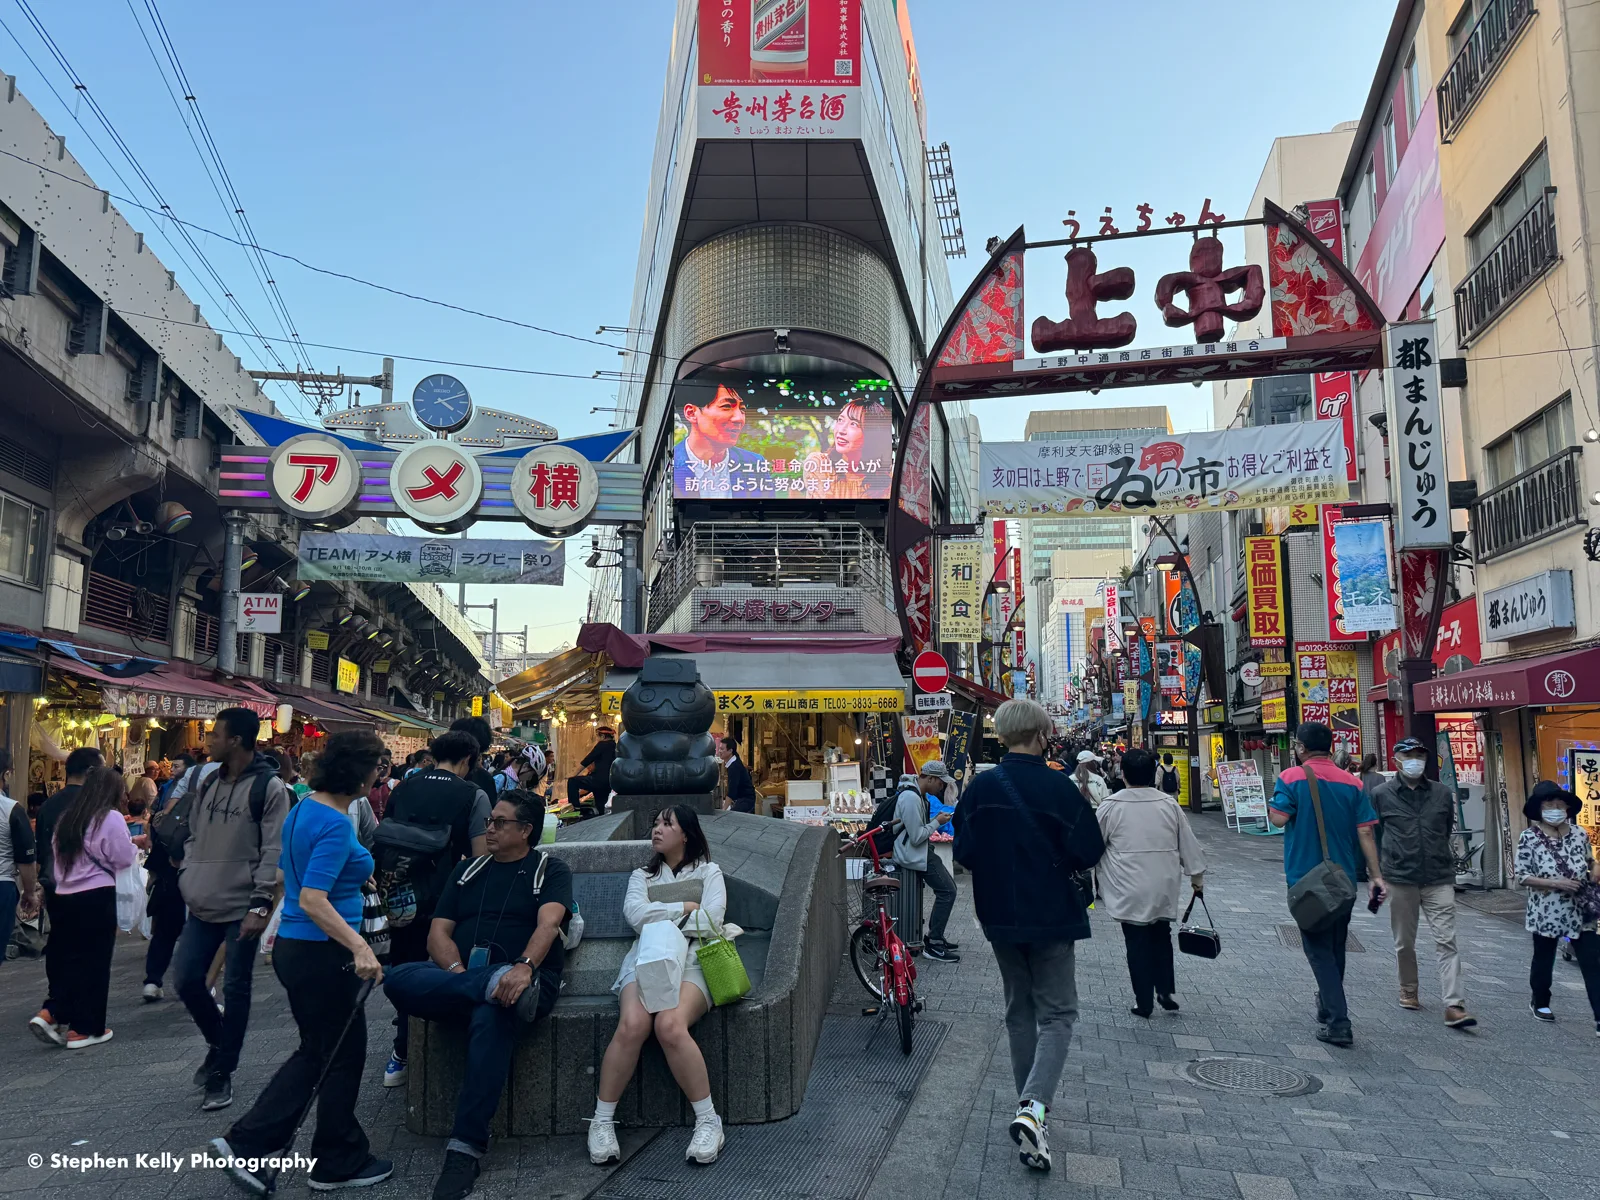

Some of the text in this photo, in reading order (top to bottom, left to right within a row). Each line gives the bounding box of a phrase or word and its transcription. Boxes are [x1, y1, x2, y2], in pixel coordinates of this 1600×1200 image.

[1062, 198, 1226, 239] うえちゅん
[1031, 237, 1266, 353] 上中
[1036, 340, 1260, 369] 上野中通商店街振興組合
[1395, 337, 1437, 529] 都まんじゅう
[1038, 442, 1134, 458] 摩利支天御縁日
[685, 458, 881, 474] マリッシュは運命の出会いが
[1228, 446, 1333, 479] お得とご利益を
[287, 452, 581, 511] アメ横
[685, 478, 834, 492] 訪れるように努めます
[992, 465, 1084, 489] 亥の日は上野で
[1092, 467, 1102, 486] 上野
[1094, 456, 1224, 509] ゐの市
[307, 548, 356, 560] TEAM
[365, 549, 412, 564] アメ横
[1250, 538, 1281, 635] 高価買取
[244, 597, 278, 608] ATM
[1344, 588, 1391, 607] モネ
[700, 598, 855, 622] アメ横センター
[950, 599, 972, 618] 食
[1488, 588, 1547, 630] 都まんじゅう
[1300, 656, 1312, 668] 金
[1330, 680, 1356, 692] ダイヤ
[718, 695, 754, 710] まぐろ
[824, 698, 898, 709] TEL03-3833-6668
[918, 696, 950, 707] 自転車を除く
[1303, 705, 1329, 716] ブランド
[1332, 730, 1358, 741] ブランド
